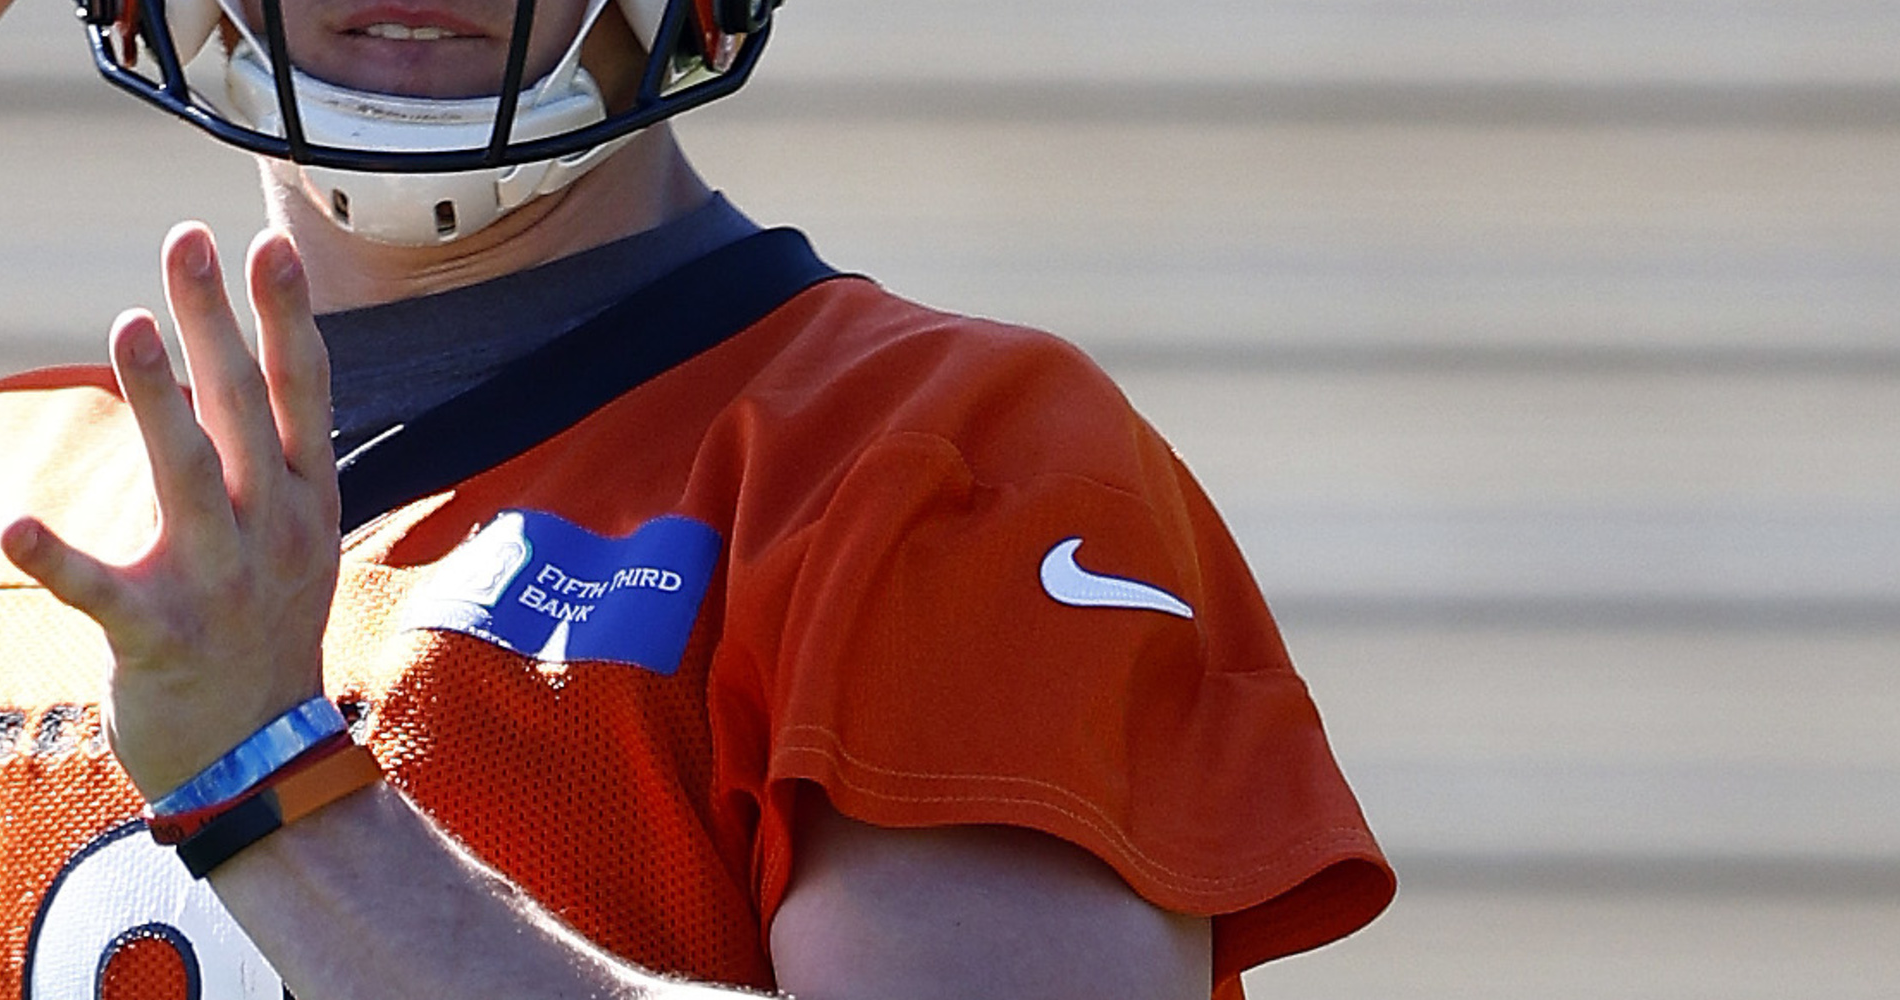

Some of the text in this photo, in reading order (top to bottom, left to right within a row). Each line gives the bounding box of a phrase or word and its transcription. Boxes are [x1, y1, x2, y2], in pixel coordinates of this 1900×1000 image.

[536, 563, 682, 599] FIFTH THIRD
[518, 584, 596, 622] BANK
